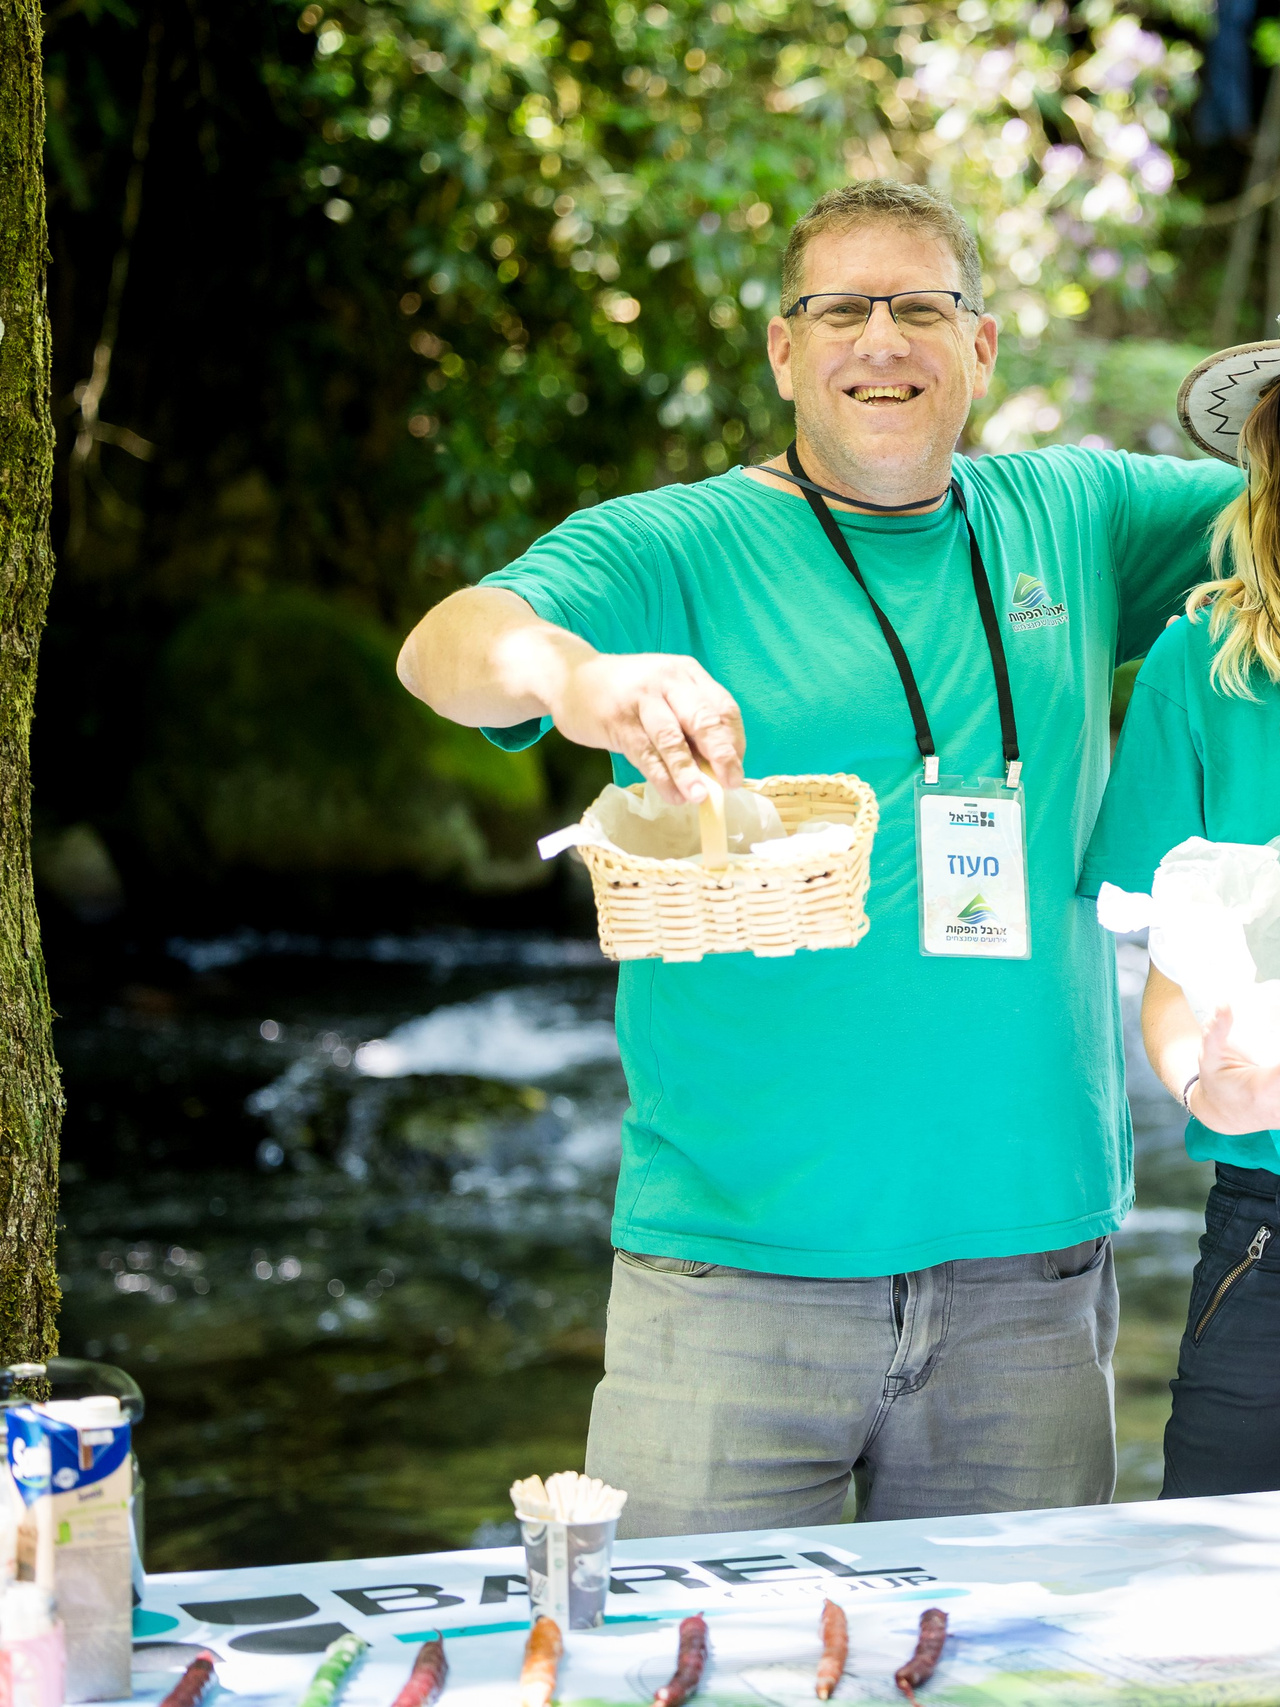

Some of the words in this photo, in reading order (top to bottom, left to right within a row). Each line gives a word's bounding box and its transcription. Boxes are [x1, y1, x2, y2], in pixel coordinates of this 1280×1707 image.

[1008, 608, 1043, 623] הפקות
[948, 811, 979, 823] בראל
[947, 854, 1000, 878] מעוז
[945, 925, 978, 935] הפקות
[980, 925, 1007, 936] ארבל
